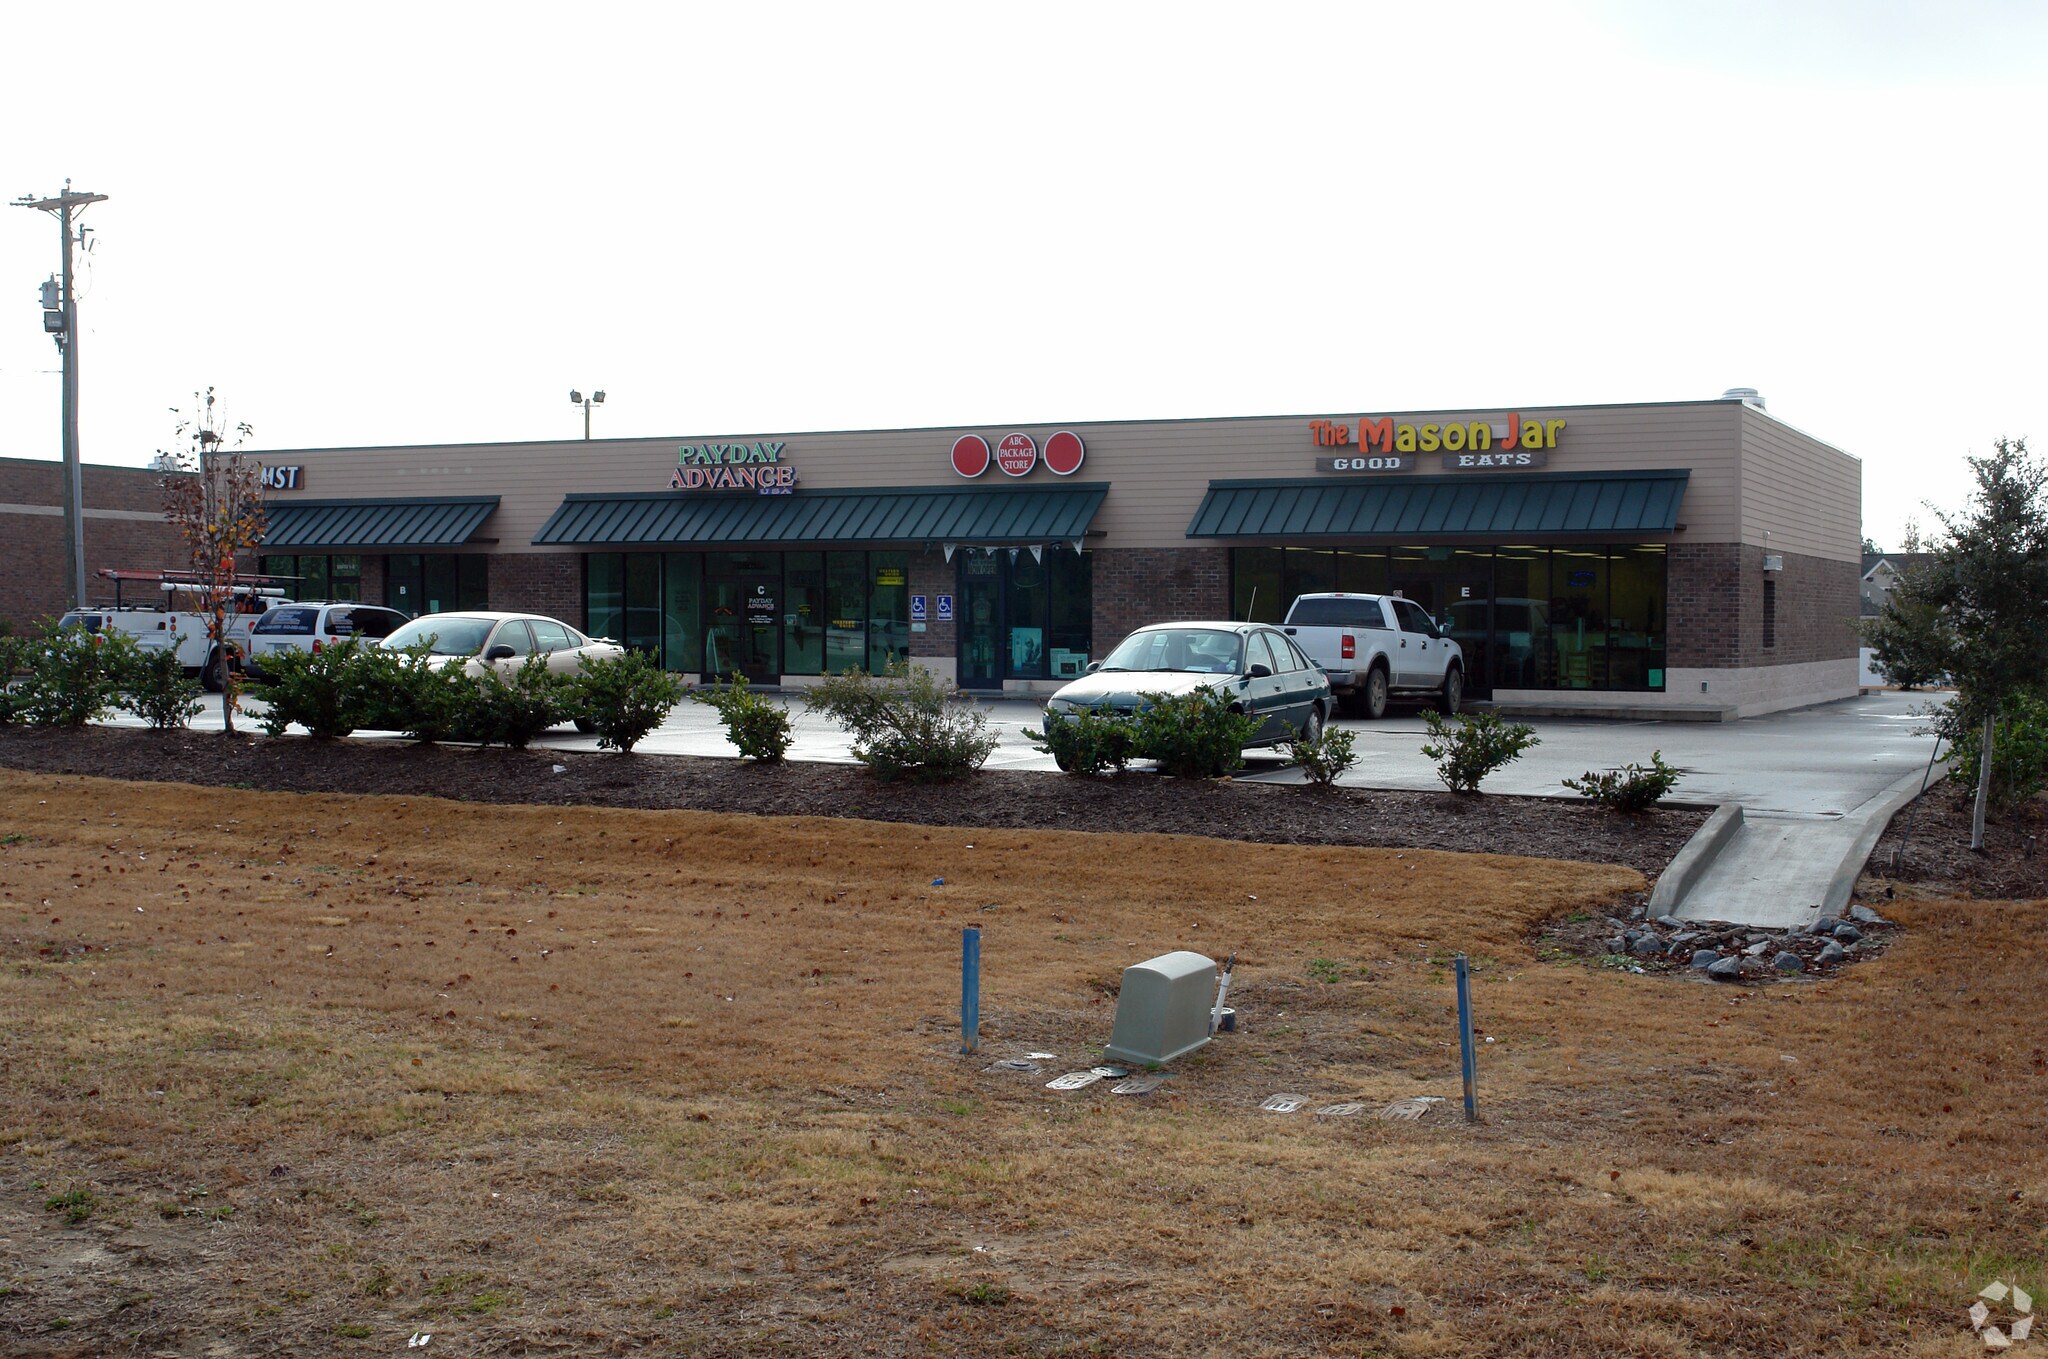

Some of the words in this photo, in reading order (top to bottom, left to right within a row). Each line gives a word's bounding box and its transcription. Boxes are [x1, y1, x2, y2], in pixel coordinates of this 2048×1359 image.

[1308, 419, 1349, 447] The
[1357, 416, 1492, 453] Mason
[1501, 412, 1567, 450] Jar
[1008, 436, 1024, 446] ABC
[678, 442, 785, 465] PAYDAY
[1000, 448, 1034, 458] PACKAGE
[1004, 460, 1029, 470] STORE
[1333, 457, 1401, 470] GOOD
[1458, 453, 1532, 467] EATS
[667, 466, 796, 489] ADVANCE
[760, 487, 792, 495] USA
[399, 586, 407, 595] B
[757, 585, 765, 595] C
[1461, 587, 1470, 597] E
